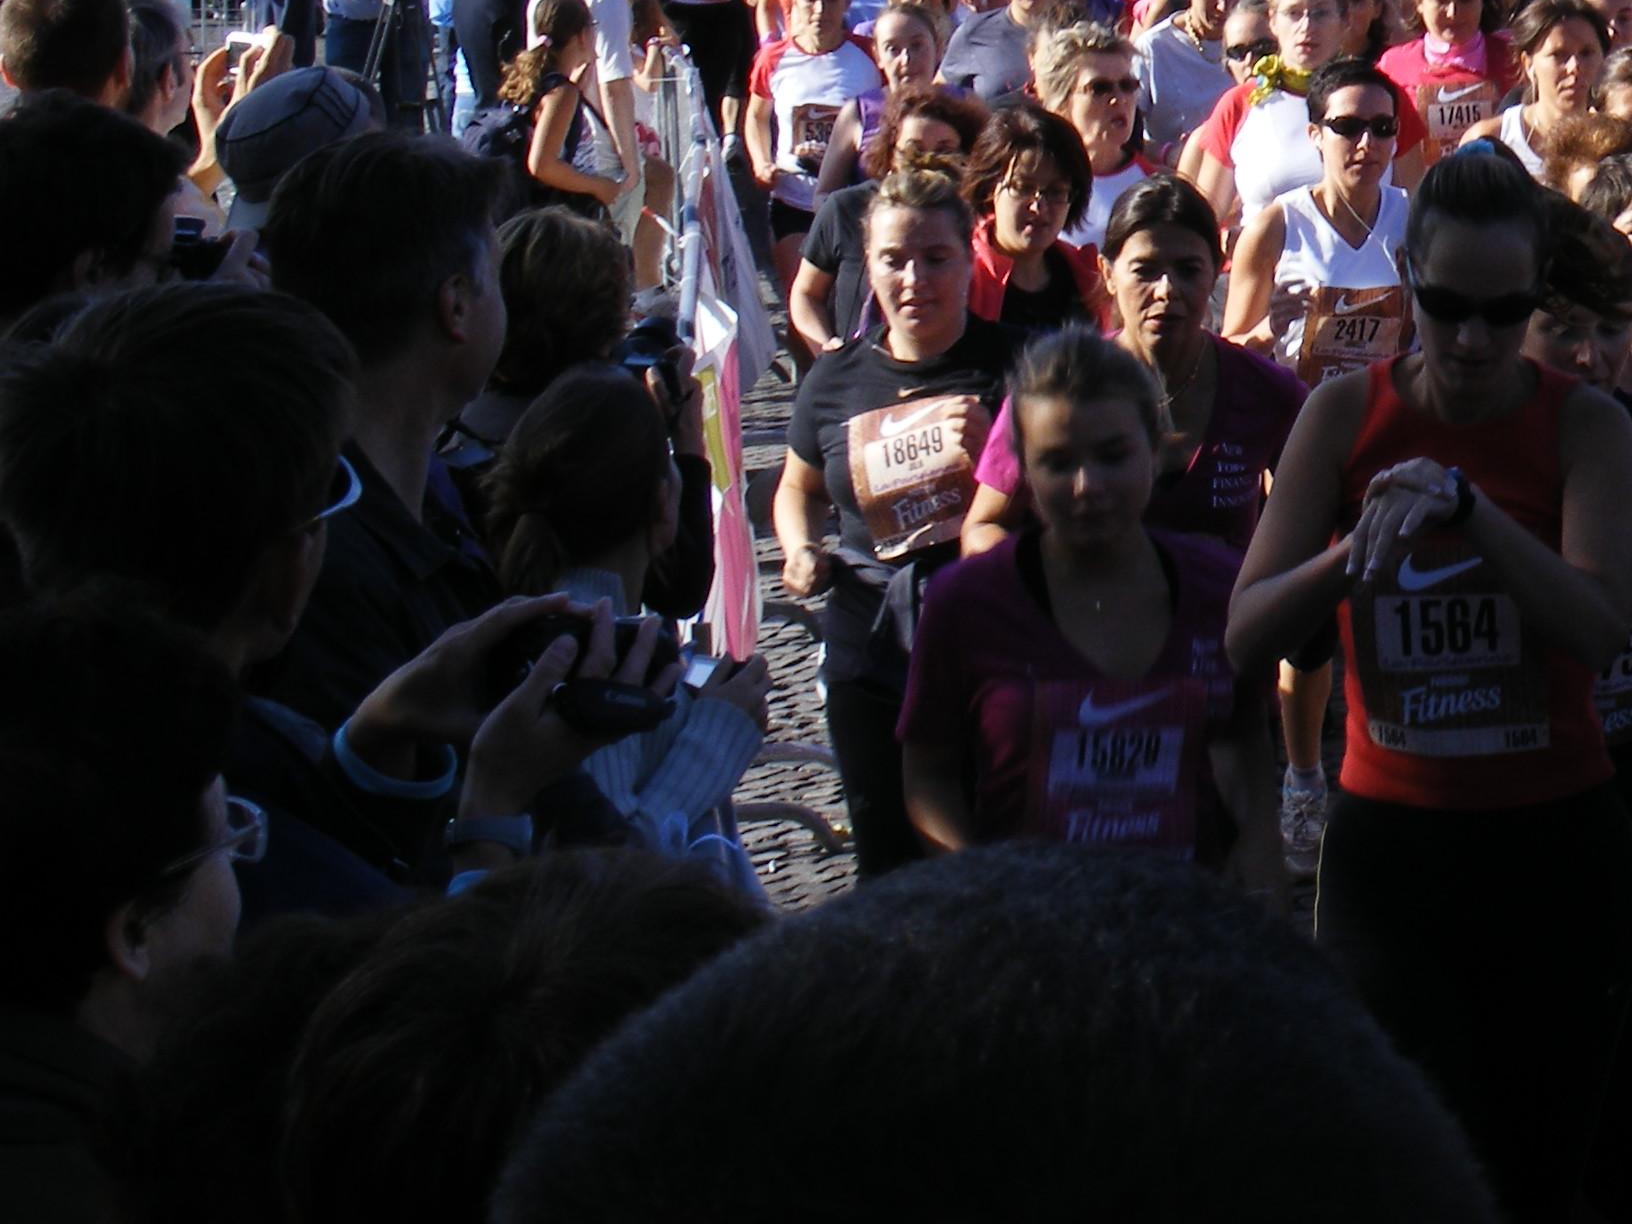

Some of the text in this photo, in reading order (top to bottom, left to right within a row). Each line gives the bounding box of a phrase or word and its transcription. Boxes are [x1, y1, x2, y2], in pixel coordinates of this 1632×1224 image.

[1439, 104, 1481, 126] 17415
[1334, 317, 1381, 343] 2417
[881, 425, 945, 469] 18649
[1395, 597, 1500, 656] 1564
[1400, 685, 1503, 726] Fitness
